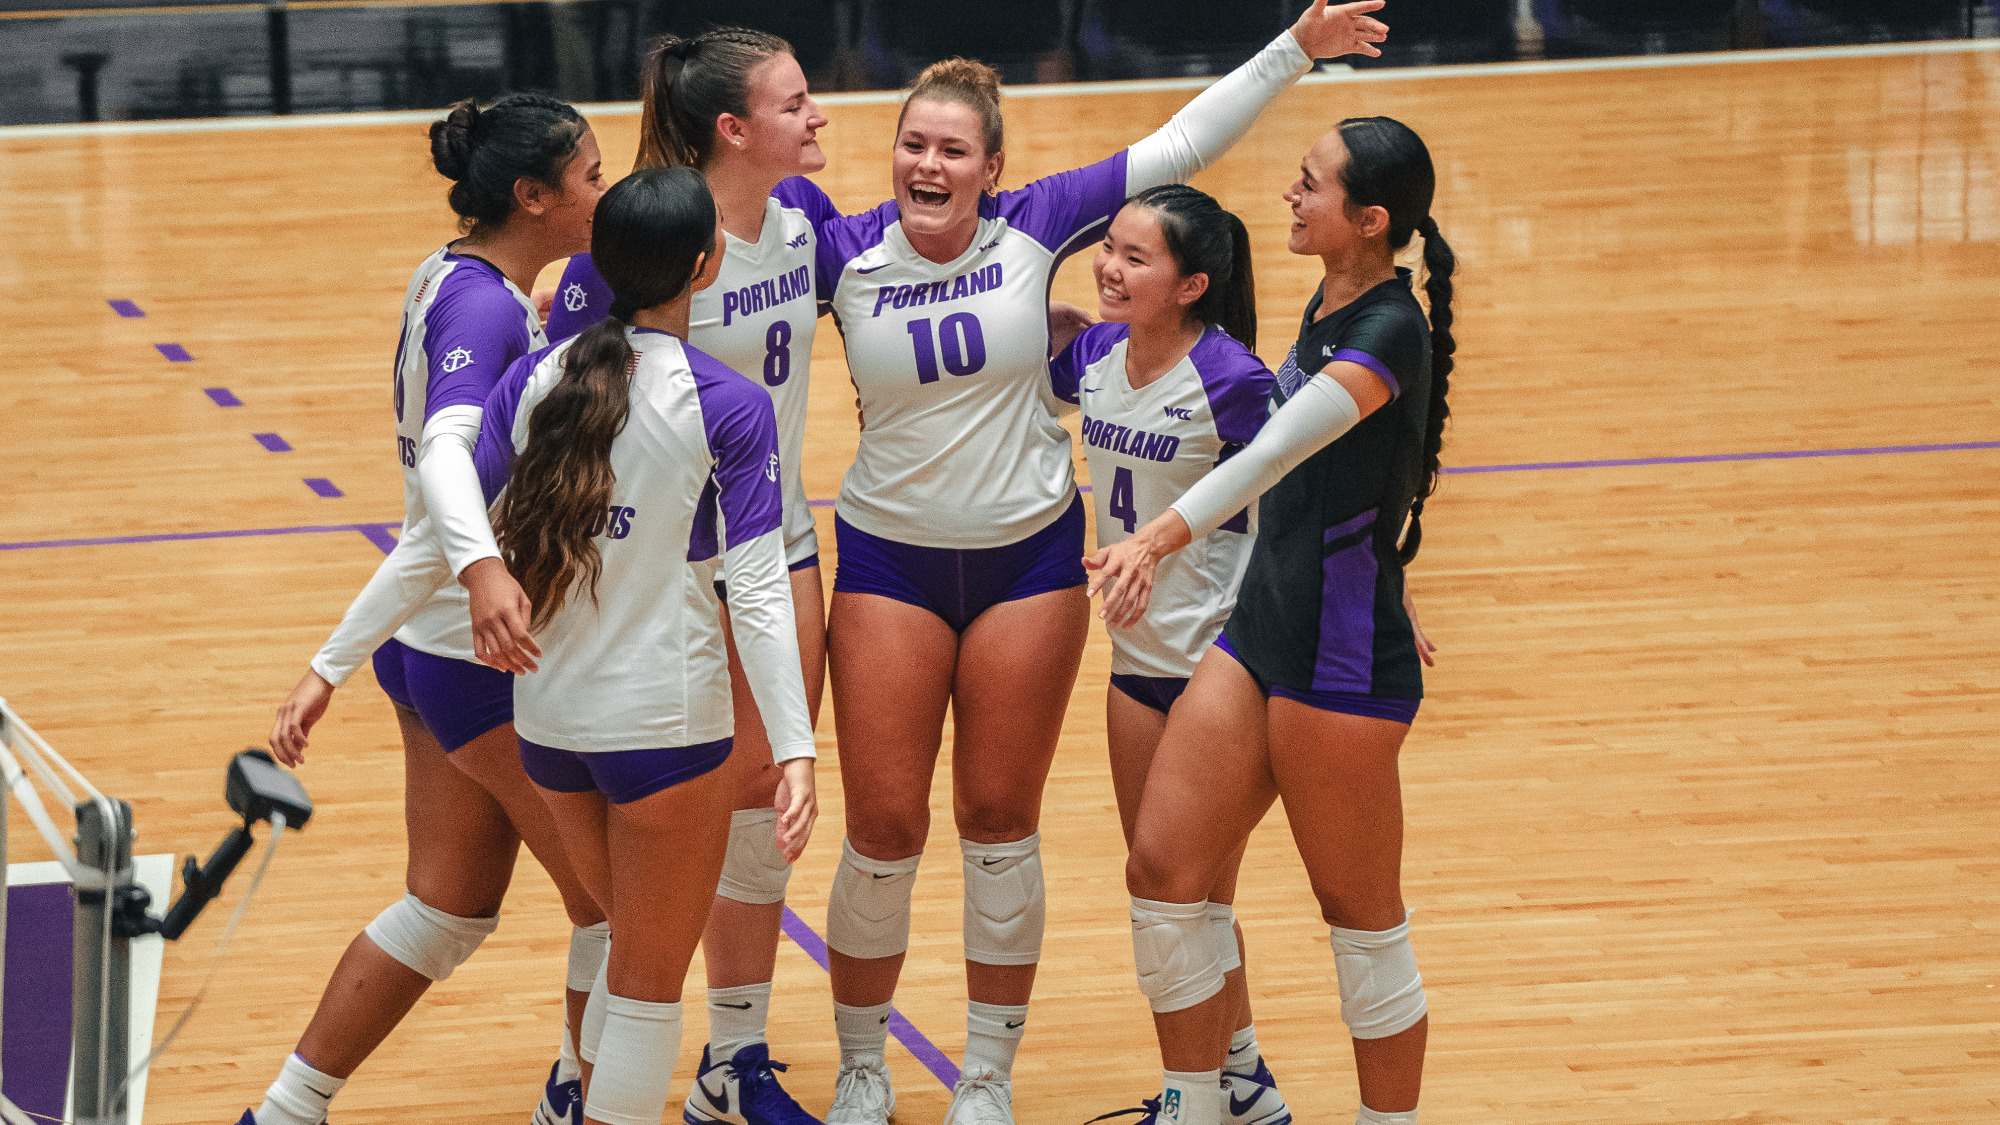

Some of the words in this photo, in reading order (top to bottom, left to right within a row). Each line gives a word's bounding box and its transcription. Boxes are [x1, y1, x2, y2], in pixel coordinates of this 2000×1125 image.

[723, 265, 810, 327] PORTLAND
[872, 263, 1002, 317] PORTLAND
[763, 320, 791, 386] 8
[907, 312, 986, 385] 10
[1082, 414, 1180, 463] PORTLAND
[1110, 466, 1137, 534] 4
